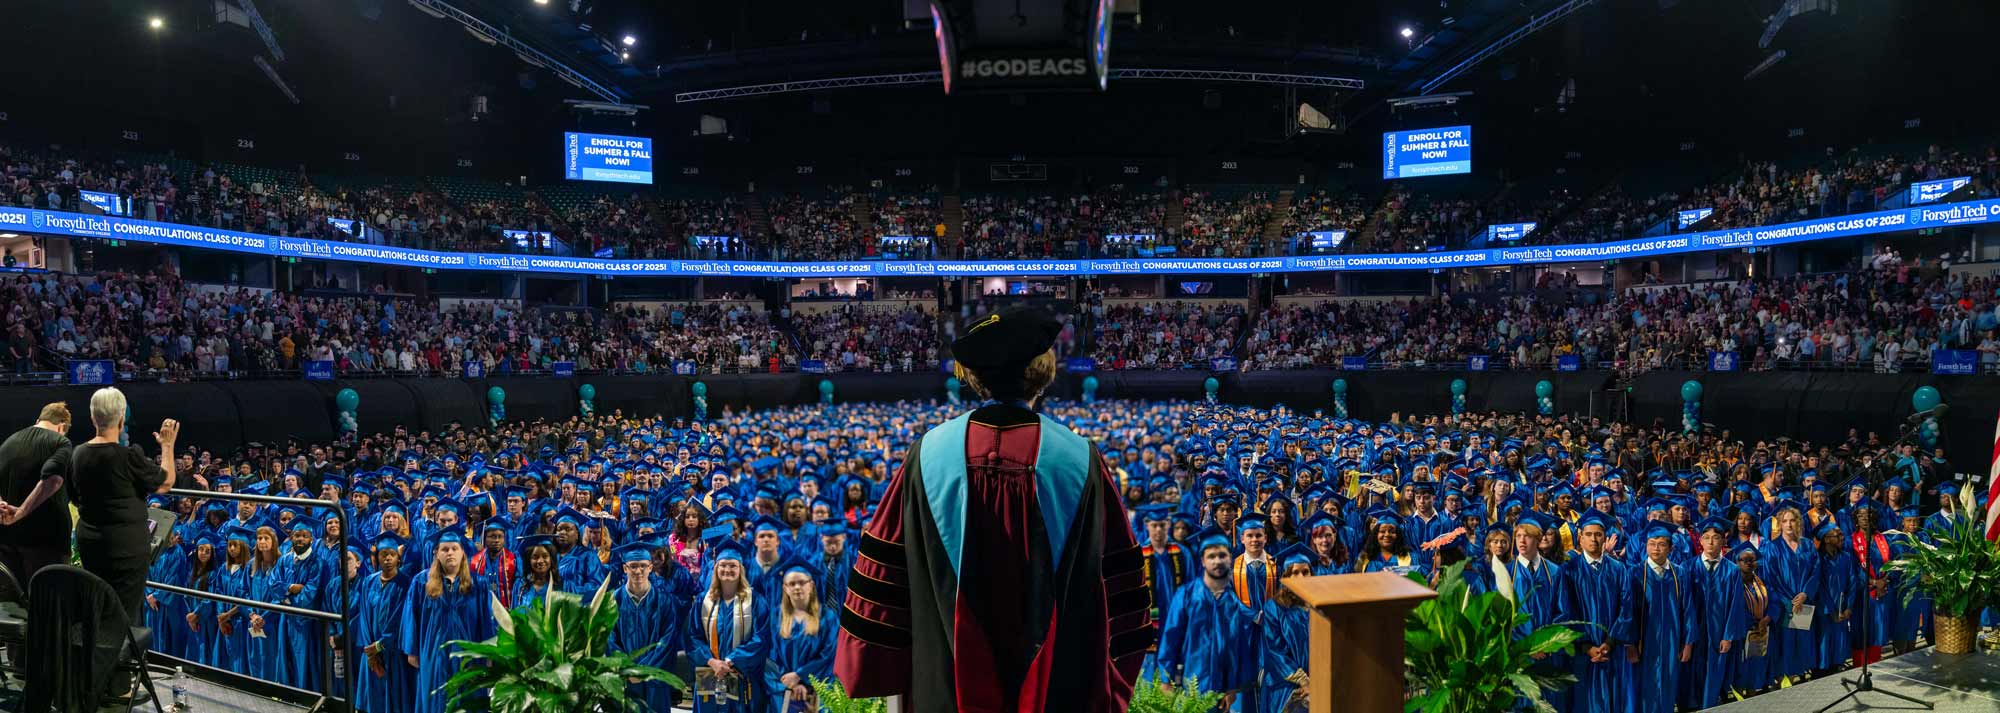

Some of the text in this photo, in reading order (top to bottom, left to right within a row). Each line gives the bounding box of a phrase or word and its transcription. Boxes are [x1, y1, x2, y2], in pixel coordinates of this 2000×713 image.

[961, 59, 1087, 78] #GODEACS
[122, 131, 139, 140] 233
[1408, 131, 1461, 142] ENROLL FOR
[237, 139, 254, 148] 234
[591, 138, 643, 149] ENROLL FOR
[1401, 142, 1439, 152] SUMMER
[1449, 139, 1470, 148] FALL
[584, 147, 622, 156] SUMMER
[631, 150, 650, 159] FALL
[1422, 151, 1447, 159] NOW!
[456, 160, 473, 168] 236
[605, 157, 630, 166] NOW!
[1222, 161, 1238, 169] 203
[1123, 166, 1139, 174] 202
[1923, 206, 1961, 223] Forsyth
[1961, 204, 1987, 218] Tech
[46, 215, 110, 232] Forsyth Tech
[1756, 214, 1905, 240] CONGRATULATIONS CLASS OF 2025!
[114, 223, 264, 248] CONGRATULATIONS CLASS OF 2025!
[1702, 235, 1733, 247] Forsyth
[1734, 231, 1753, 242] Tech
[280, 240, 311, 254] Forsyth
[311, 243, 330, 253] Tech
[1555, 238, 1687, 256] CONGRATULATIONS CLASS OF 2025!
[334, 246, 407, 261] CONGRATULATIONS
[408, 254, 429, 263] CLASS
[430, 256, 440, 264] OF
[441, 256, 463, 265] 2025!
[1348, 254, 1485, 266] CONGRATULATIONS CLASS OF 2025!
[1503, 250, 1532, 261] Forsyth
[1532, 249, 1552, 259] Tech
[479, 256, 528, 267] Forsyth Tech
[531, 259, 604, 270] CONGRATULATIONS
[605, 263, 630, 271] CLASS
[1091, 262, 1121, 272] Forsyth
[1121, 262, 1140, 270] Tech
[1261, 261, 1282, 269] 2025!
[1297, 258, 1326, 268] Forsyth
[1327, 257, 1345, 266] Tech
[681, 263, 730, 272] Forsyth Tech
[733, 264, 809, 273] CONGRATULATIONS
[811, 265, 835, 273] CLASS
[837, 265, 848, 273] OF
[885, 263, 934, 273] Forsyth Tech
[937, 264, 1015, 272] CONGRATULATIONS
